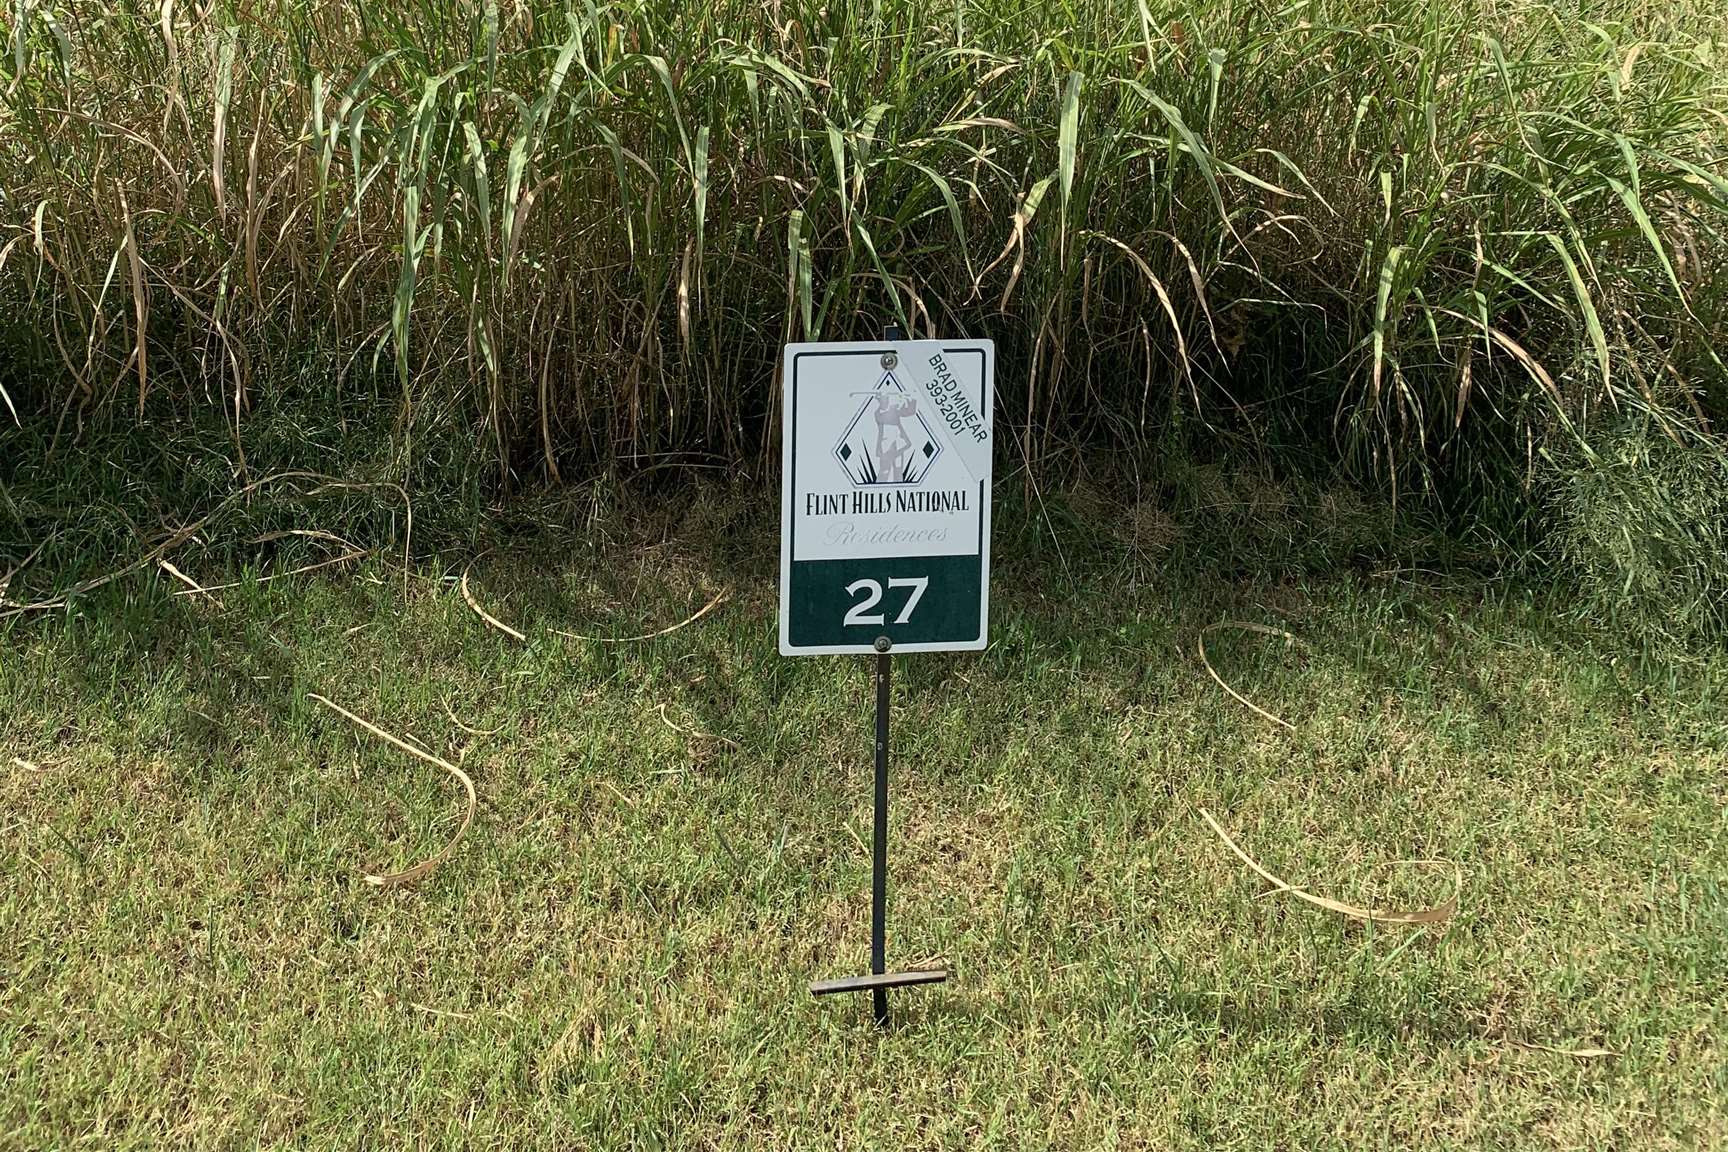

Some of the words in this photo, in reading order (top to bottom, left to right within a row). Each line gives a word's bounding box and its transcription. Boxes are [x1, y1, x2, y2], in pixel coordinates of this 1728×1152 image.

[926, 379, 966, 435] 393-2001
[929, 353, 957, 391] BRAD
[951, 391, 987, 443] MINEAR
[806, 492, 848, 515] FLINT
[852, 491, 892, 514] HILLS
[896, 489, 969, 512] NATIONAL
[824, 521, 948, 546] Residences
[843, 576, 929, 627] 27
